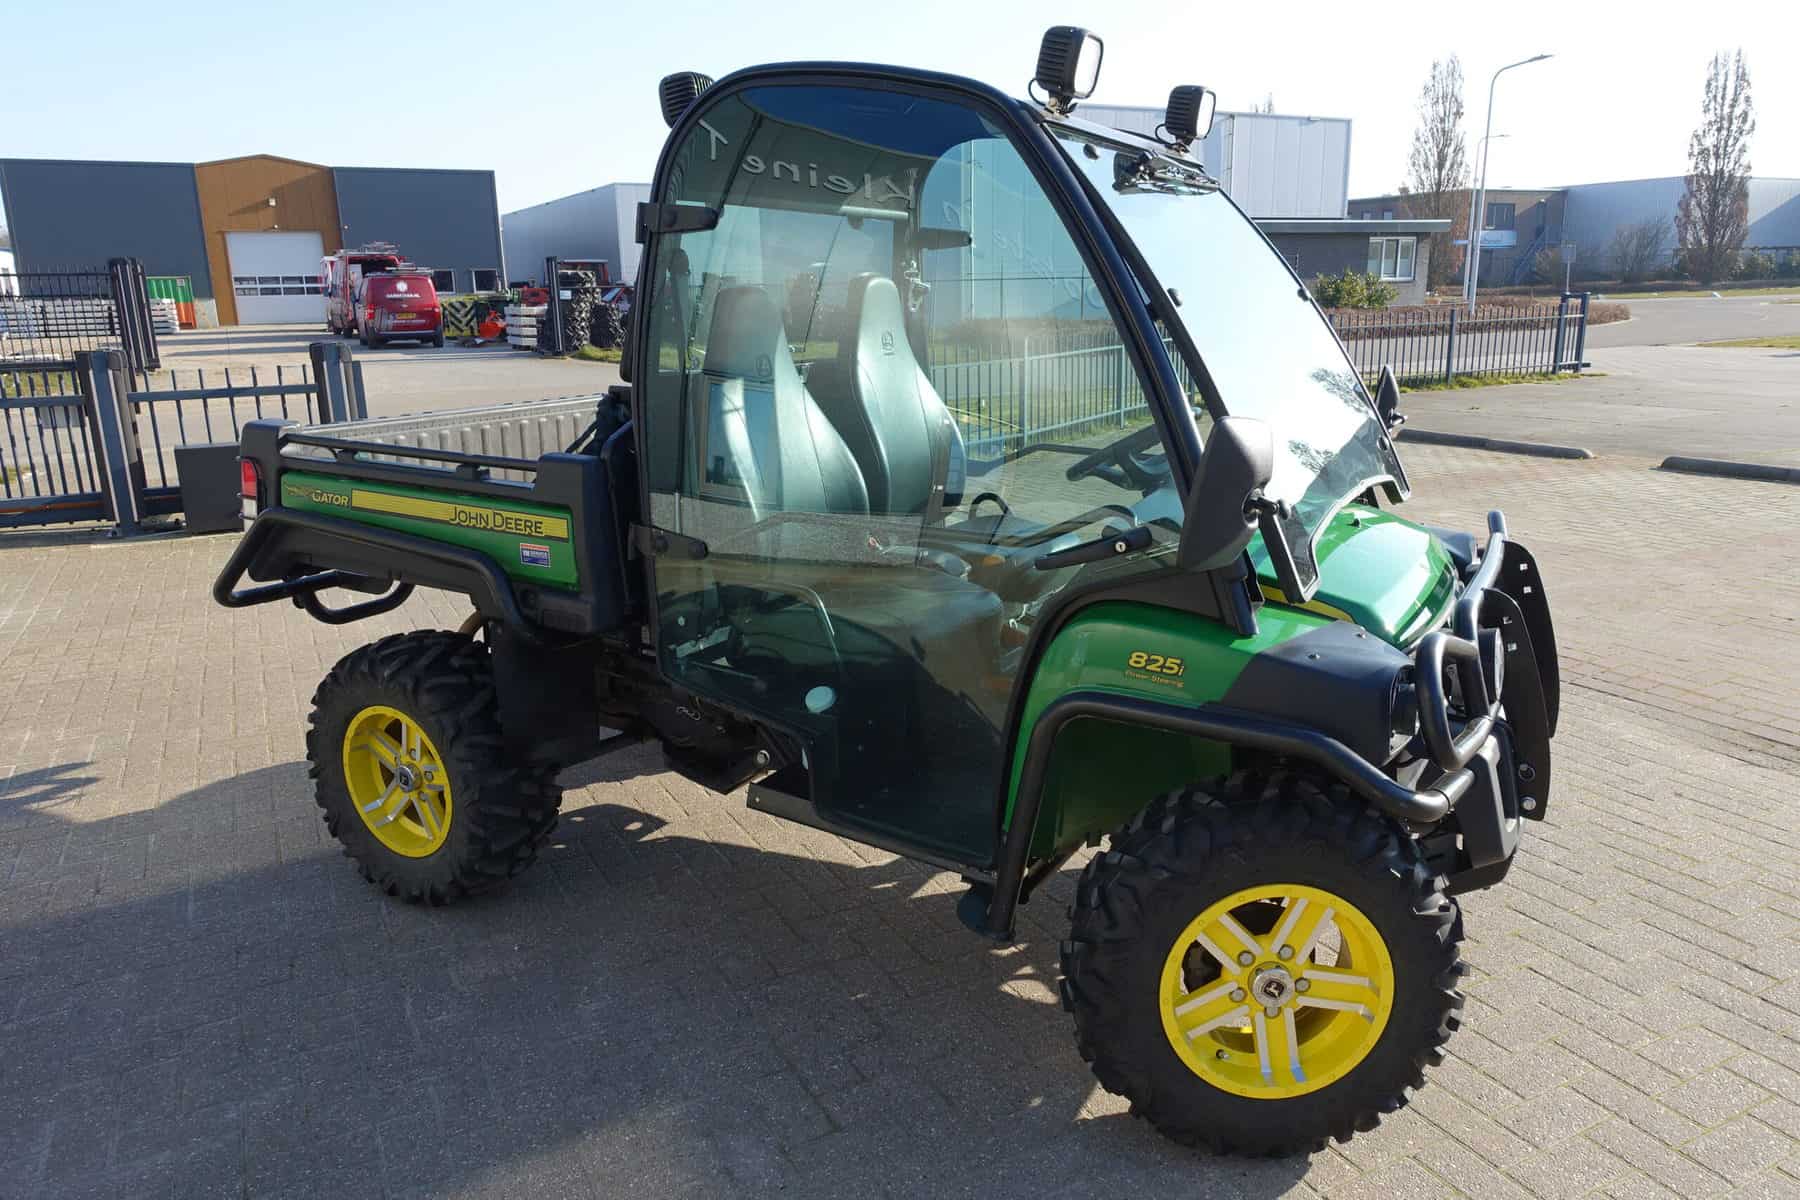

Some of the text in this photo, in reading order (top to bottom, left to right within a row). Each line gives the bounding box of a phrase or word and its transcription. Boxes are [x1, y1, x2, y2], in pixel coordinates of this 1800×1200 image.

[311, 489, 349, 507] GATOR
[449, 505, 544, 535] JOHN DEERE
[1128, 651, 1185, 676] 825i
